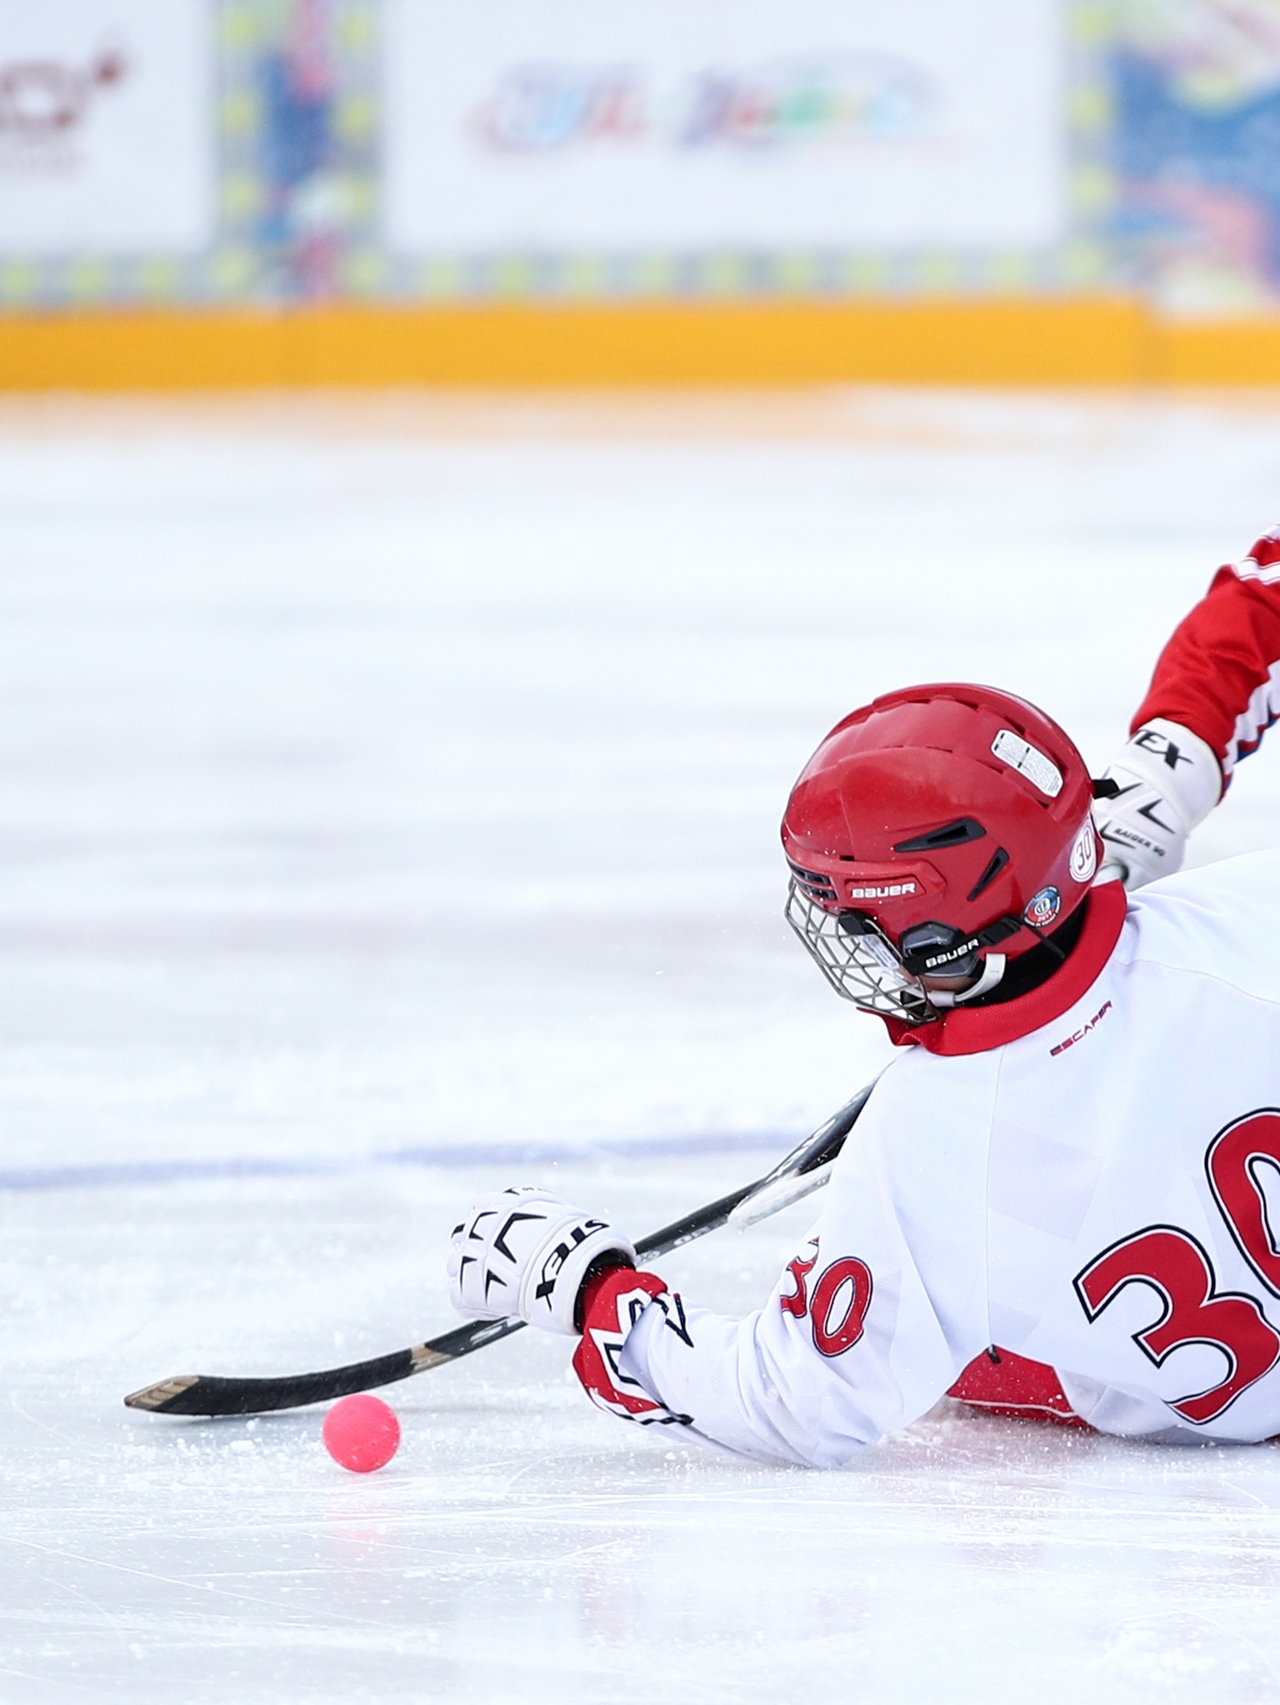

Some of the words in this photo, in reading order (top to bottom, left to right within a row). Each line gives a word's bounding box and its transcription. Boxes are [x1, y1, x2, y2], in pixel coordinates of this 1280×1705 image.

[1077, 829, 1092, 871] 30
[852, 882, 916, 898] BAUER
[925, 938, 979, 968] BAUER
[535, 1218, 610, 1312] STEX
